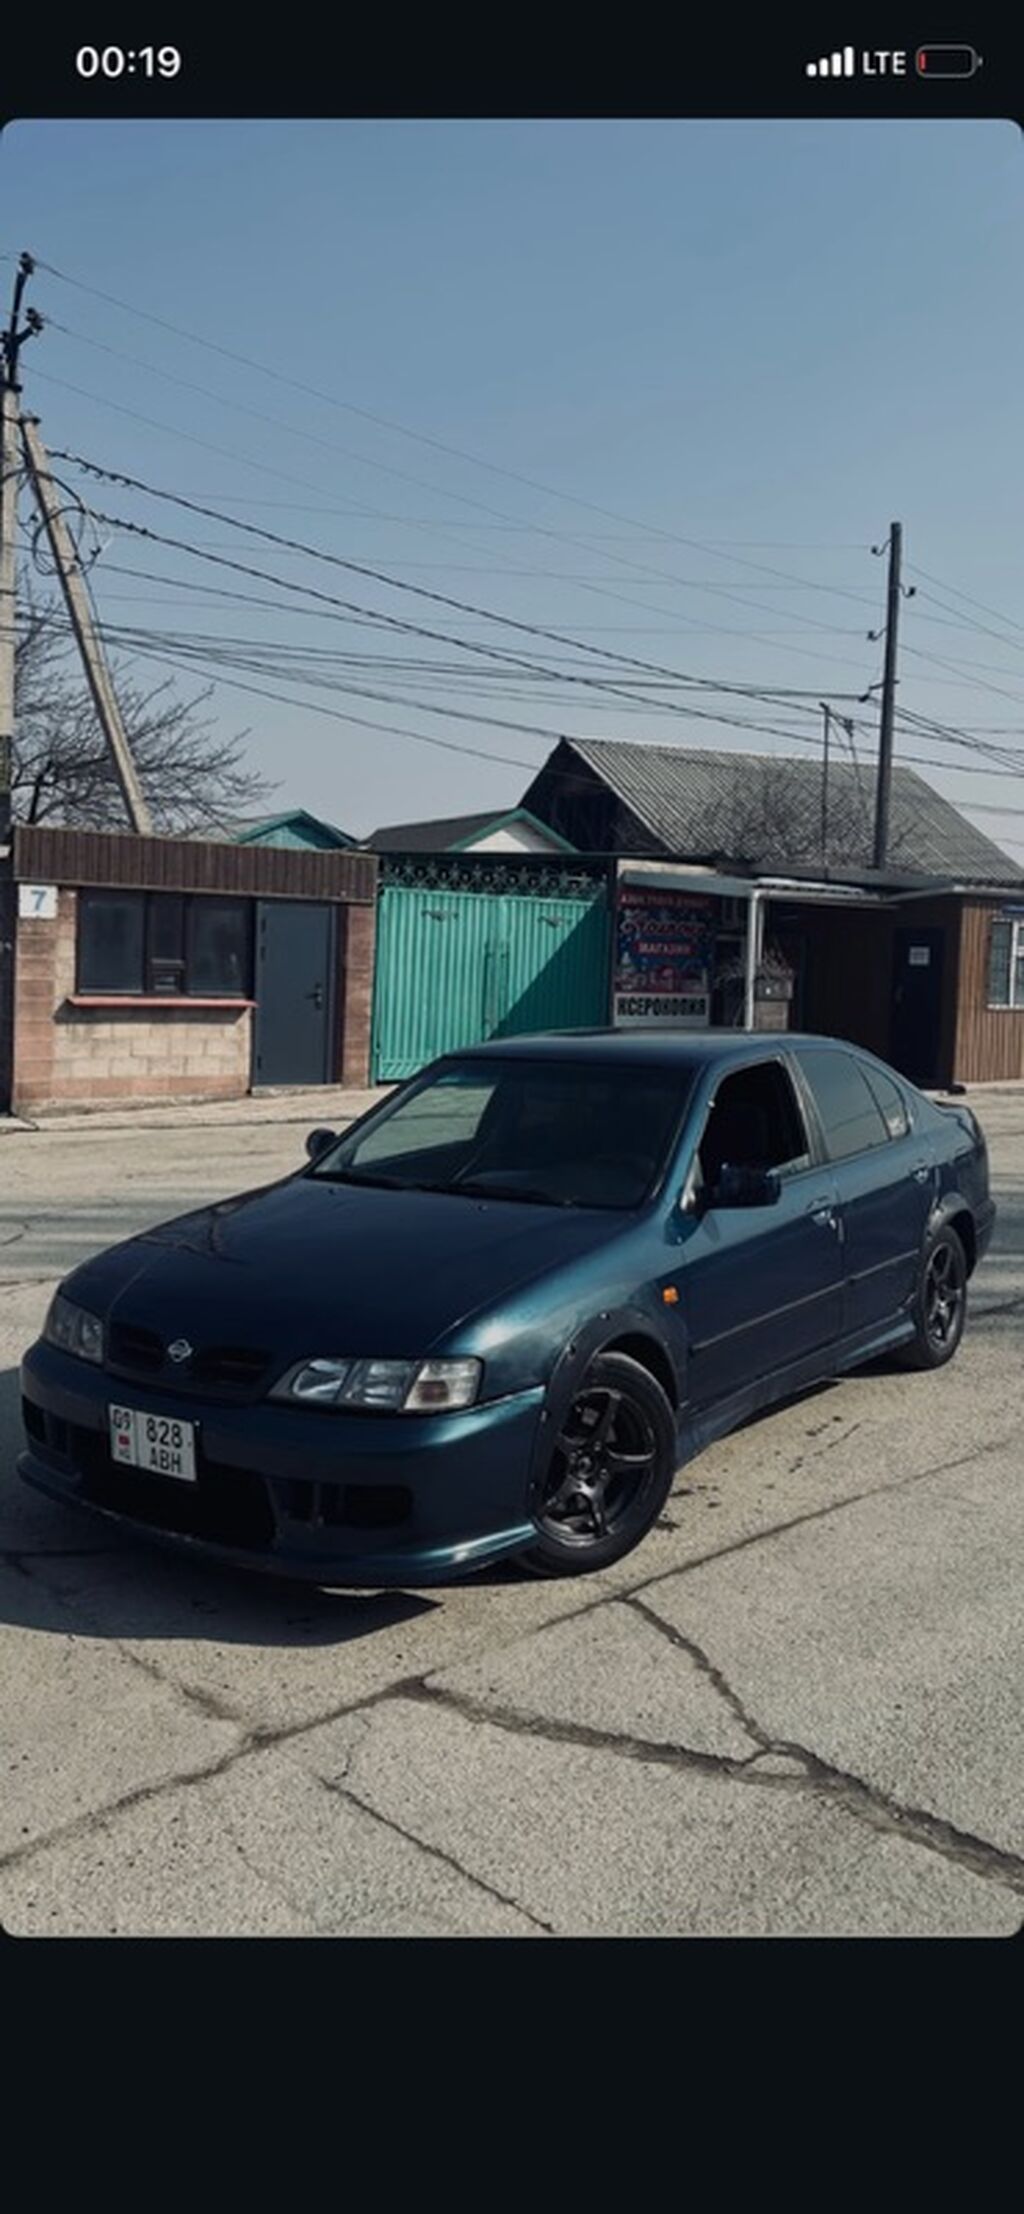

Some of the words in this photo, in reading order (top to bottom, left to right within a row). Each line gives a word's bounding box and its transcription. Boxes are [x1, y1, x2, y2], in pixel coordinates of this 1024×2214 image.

[30, 889, 47, 911] 7
[146, 1416, 183, 1449] 828
[149, 1446, 182, 1474] ABH
